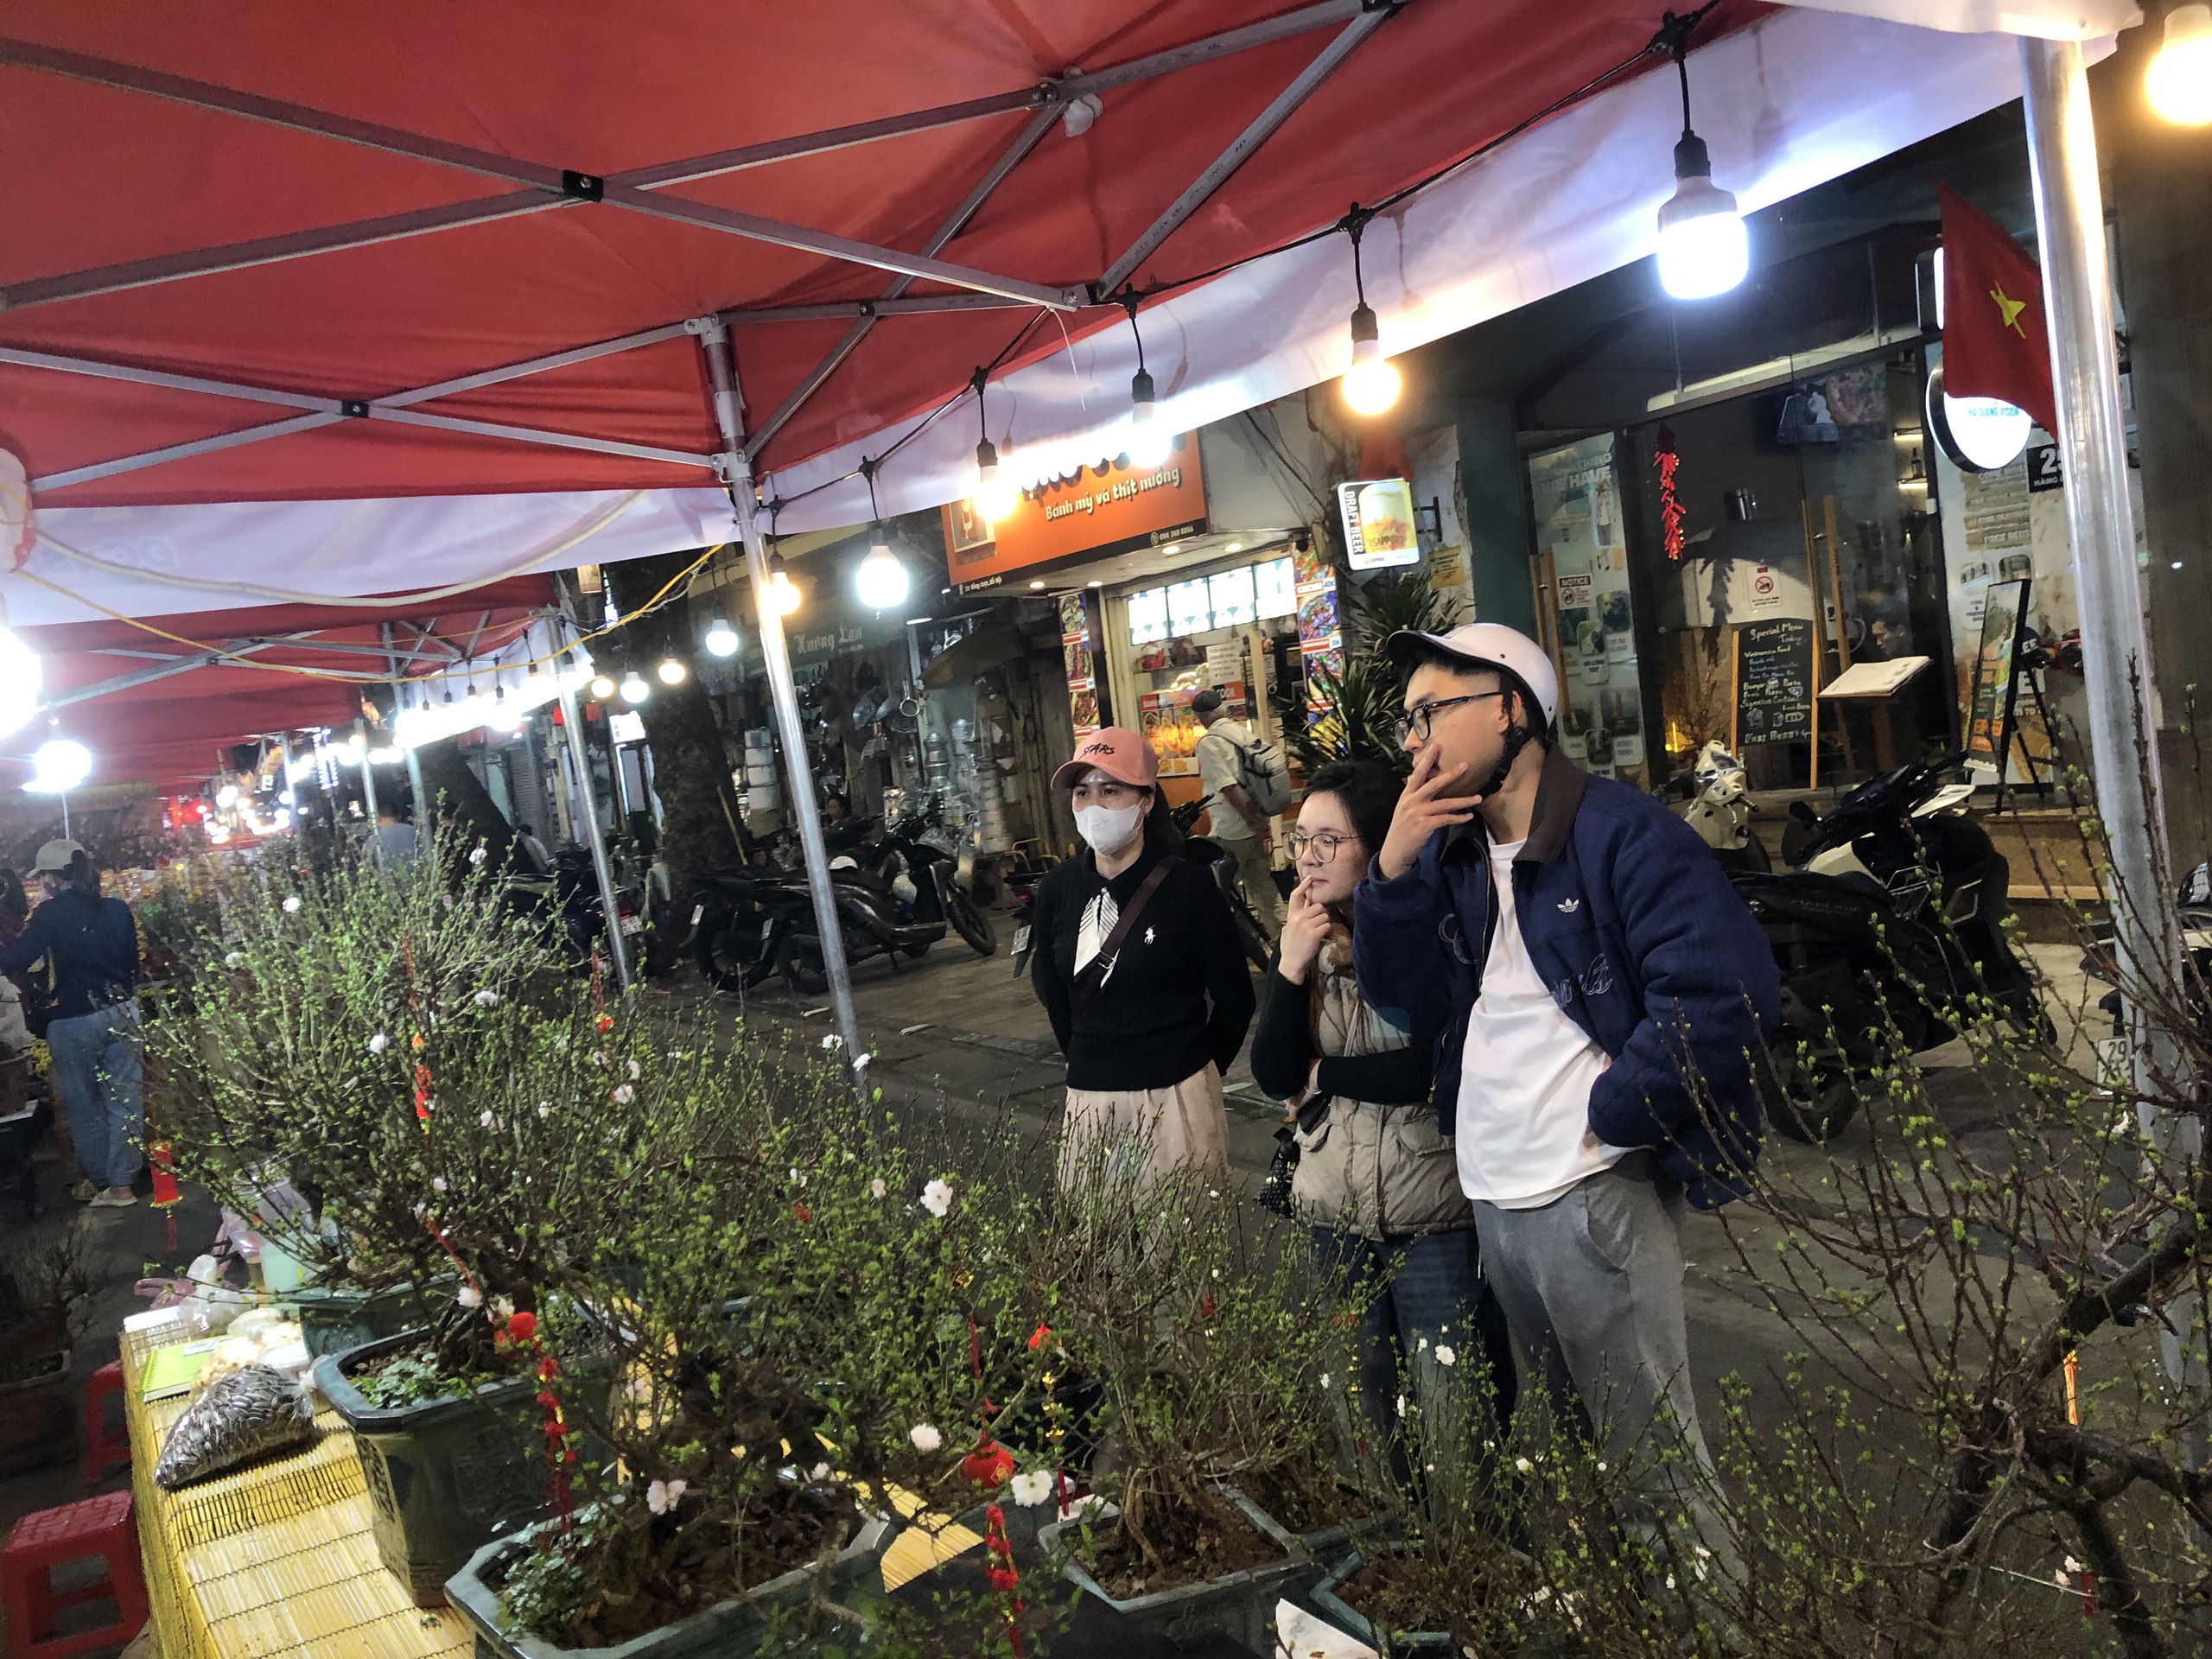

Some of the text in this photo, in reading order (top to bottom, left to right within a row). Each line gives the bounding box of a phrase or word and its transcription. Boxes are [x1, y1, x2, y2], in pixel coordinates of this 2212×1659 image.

[2040, 448, 2062, 474] 2
[1568, 465, 1611, 488] HAVE
[1046, 500, 1073, 521] Bánh
[1096, 487, 1110, 505] và
[1112, 479, 1137, 501] thịt
[1140, 466, 1181, 493] nướng
[1344, 490, 1364, 554] DRAFT BEER
[1561, 576, 1589, 588] NOTICE
[1750, 622, 1803, 642] Special Menu
